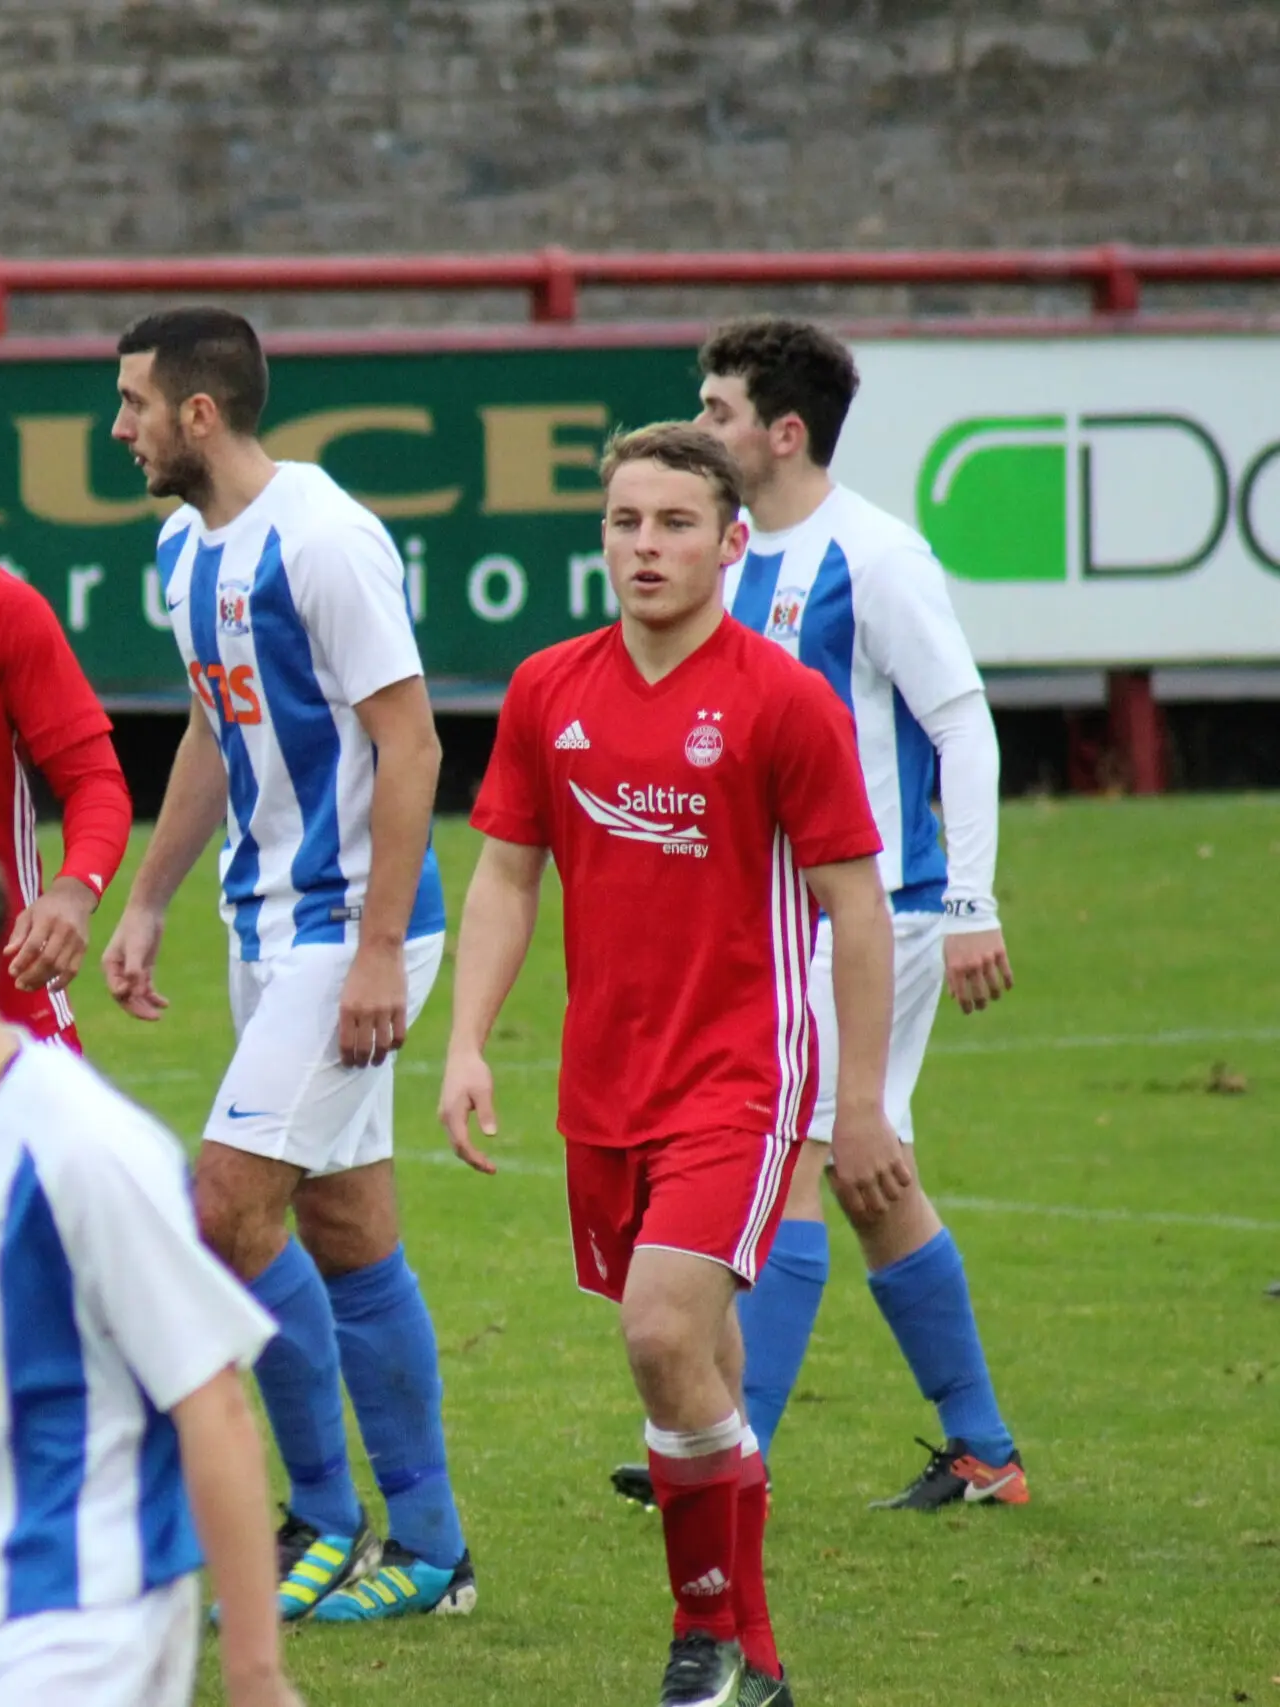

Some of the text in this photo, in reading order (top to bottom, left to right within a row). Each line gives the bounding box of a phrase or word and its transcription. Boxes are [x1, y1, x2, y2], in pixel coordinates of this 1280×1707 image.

[554, 739, 591, 750] adidas
[617, 782, 707, 816] Saltire
[662, 843, 709, 859] energy
